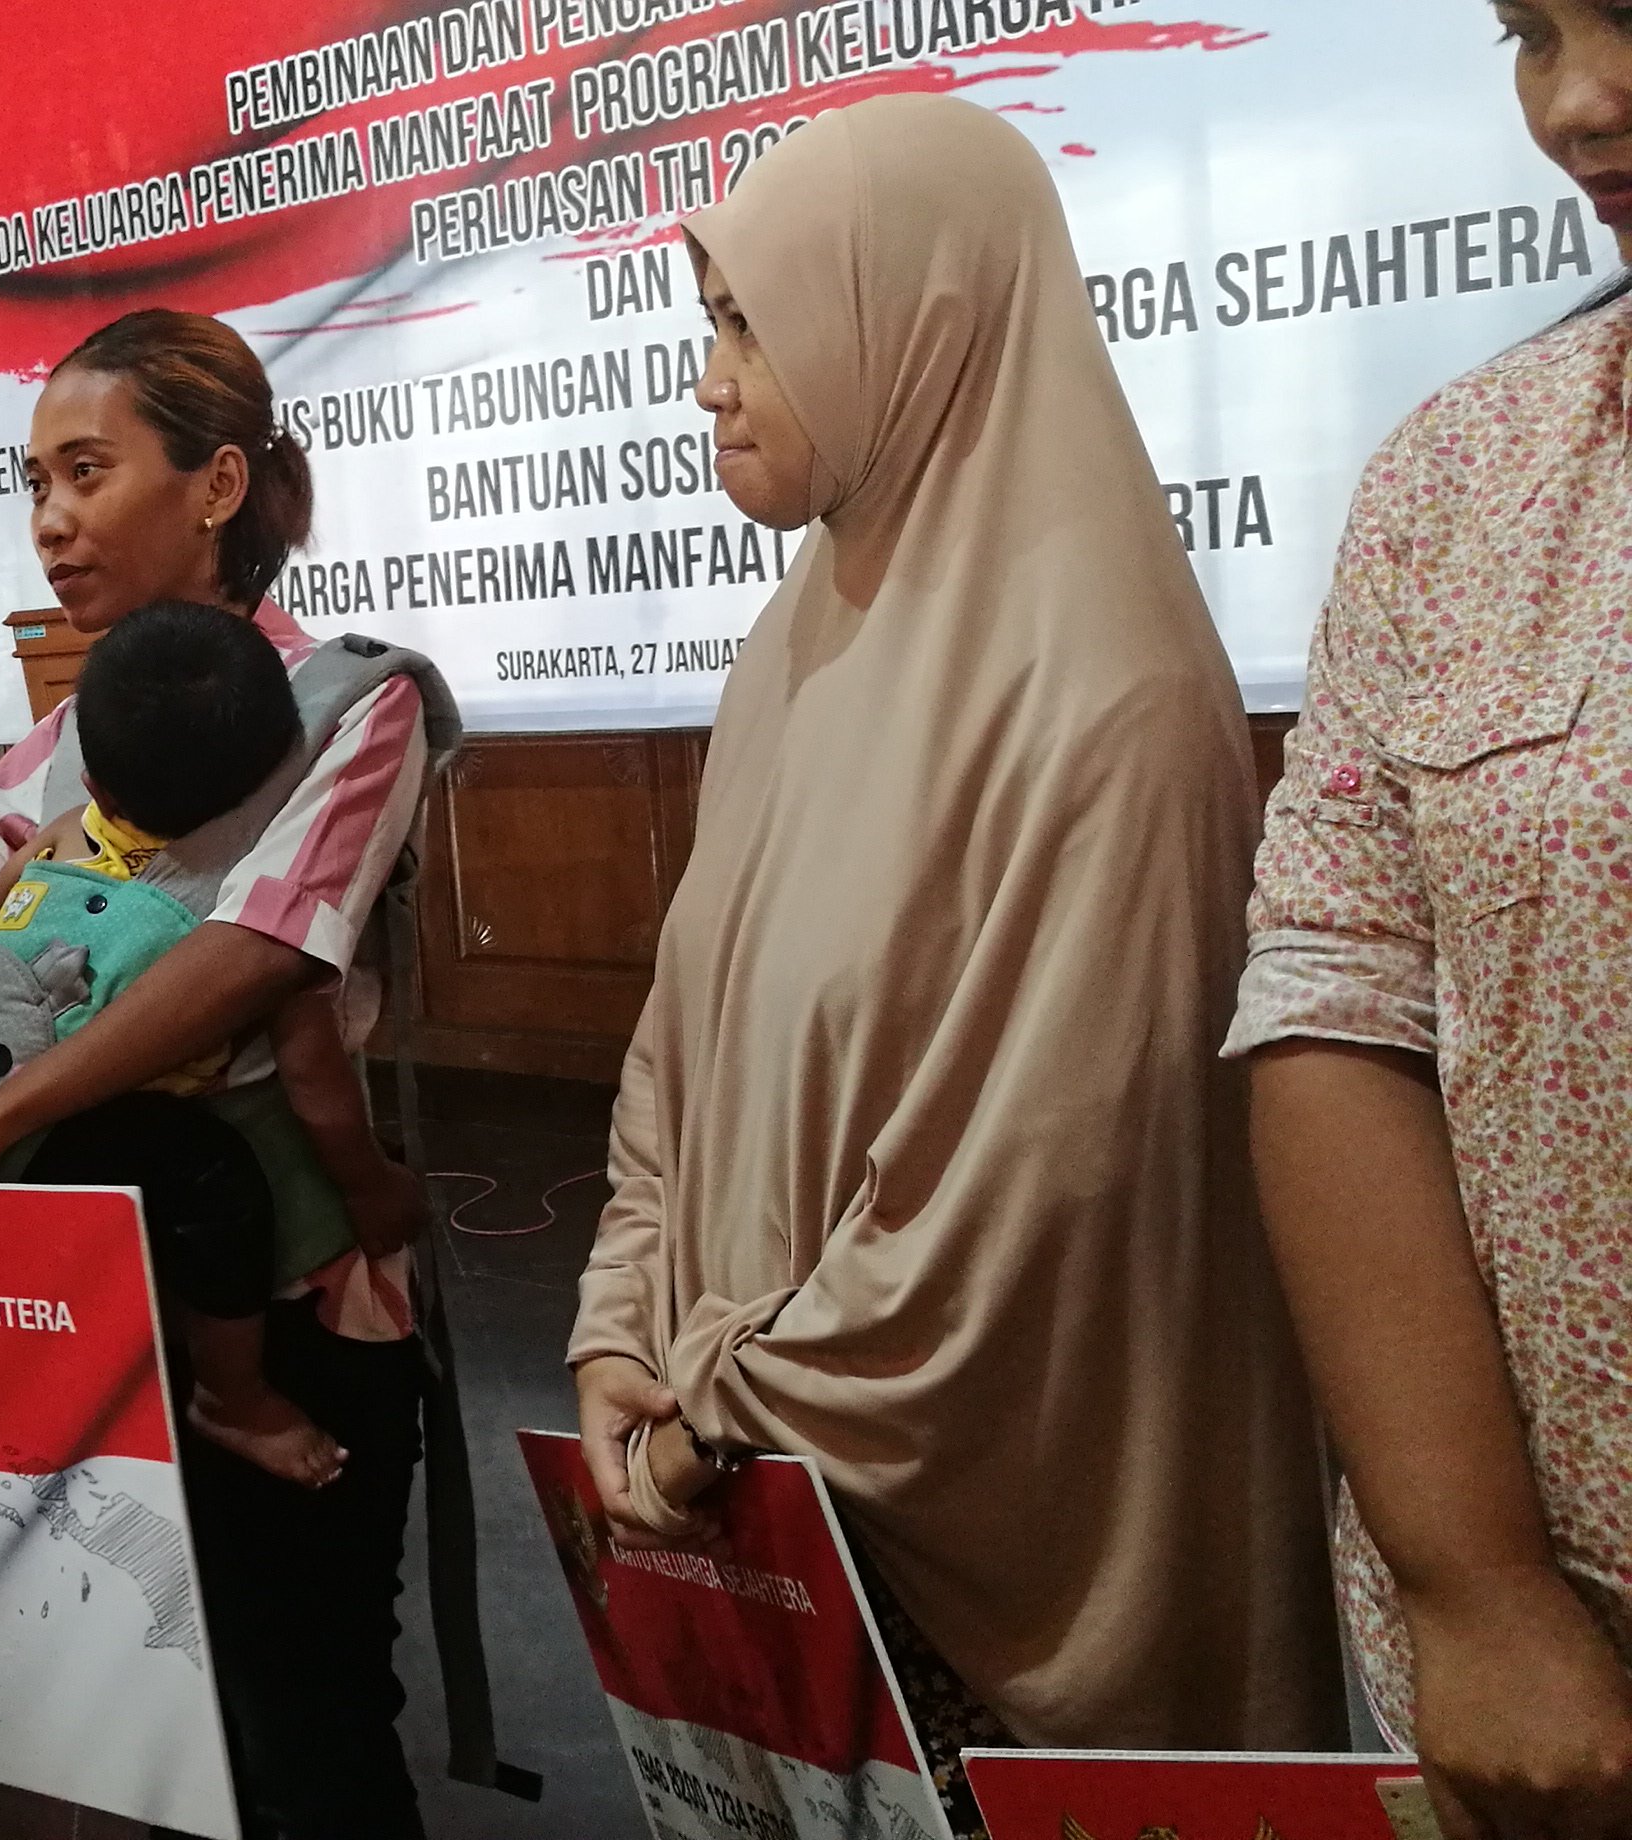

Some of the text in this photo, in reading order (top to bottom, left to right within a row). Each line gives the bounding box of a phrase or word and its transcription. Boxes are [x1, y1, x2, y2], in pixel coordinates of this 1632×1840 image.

[226, 20, 436, 134] PEMBINAAN
[442, 2, 525, 76] DAN
[34, 175, 186, 263] KELUARGA
[193, 129, 363, 225] PENERIMA
[370, 79, 553, 184] MANFAAT
[575, 18, 787, 137] PROGRAM
[413, 154, 646, 259] PERLUASAN
[653, 139, 713, 213] TH
[321, 382, 414, 451] BUKU
[423, 347, 633, 434] TABUNGAN
[644, 335, 716, 406] DA
[1084, 260, 1199, 343] RGA
[1214, 197, 1592, 327] SEJAHTERA
[586, 247, 672, 321] DAN
[427, 431, 726, 522] BANTUAN SOSI
[277, 475, 1273, 618] ARGA PENERIMA MANFAAT RTA
[496, 644, 625, 681] SURAKARTA,
[630, 642, 658, 676] 27
[651, 1550, 726, 1592] KELUARGA
[720, 1564, 817, 1617] SEJAHTERA
